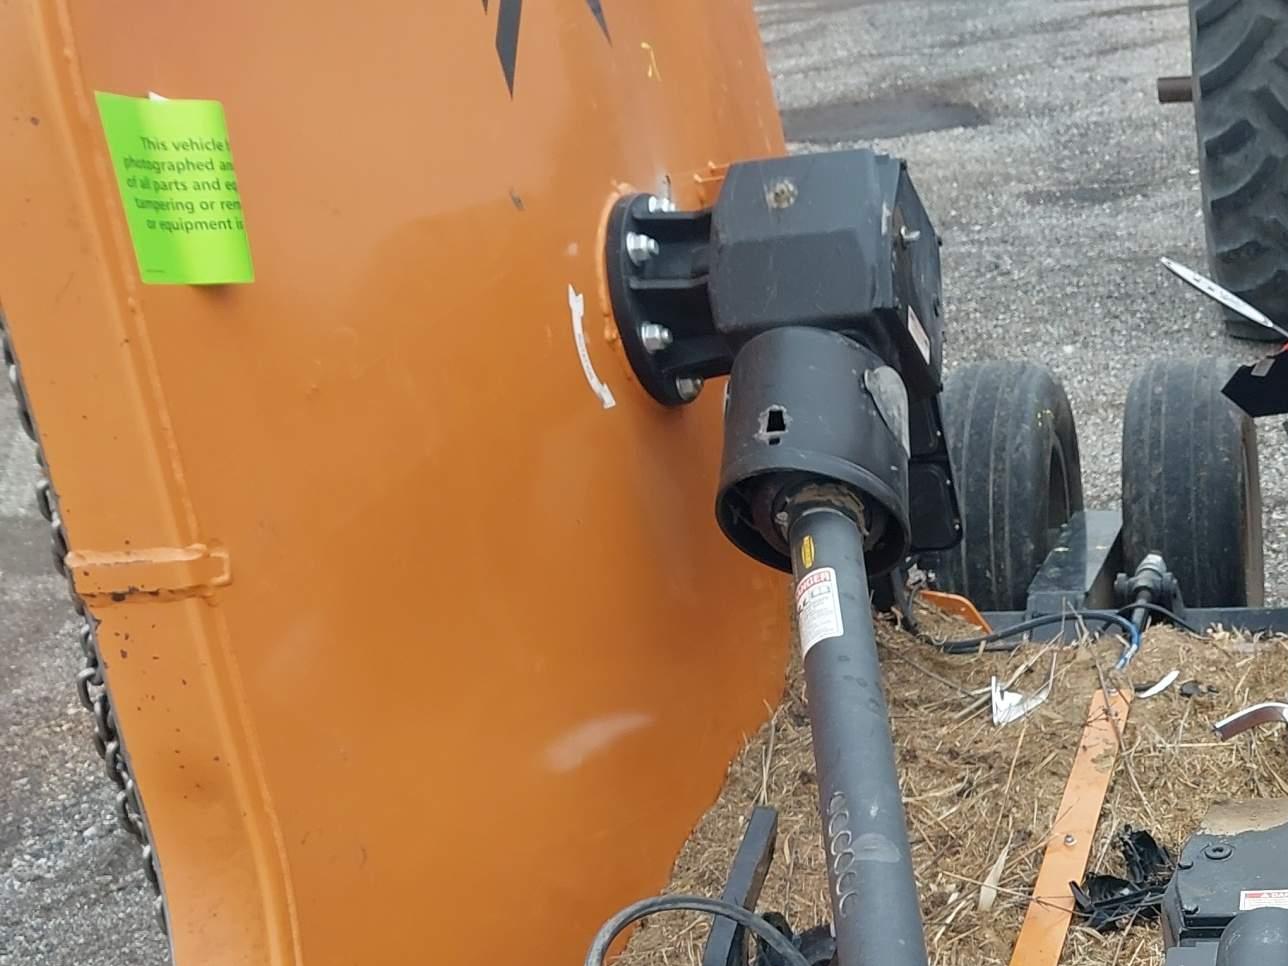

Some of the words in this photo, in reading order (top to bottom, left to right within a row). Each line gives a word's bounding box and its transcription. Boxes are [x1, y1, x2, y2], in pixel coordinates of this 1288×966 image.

[140, 136, 167, 151] This
[172, 136, 224, 151] vehicle
[153, 179, 188, 194] parts
[193, 178, 221, 191] and
[200, 201, 215, 210] or
[159, 218, 232, 234] equipment
